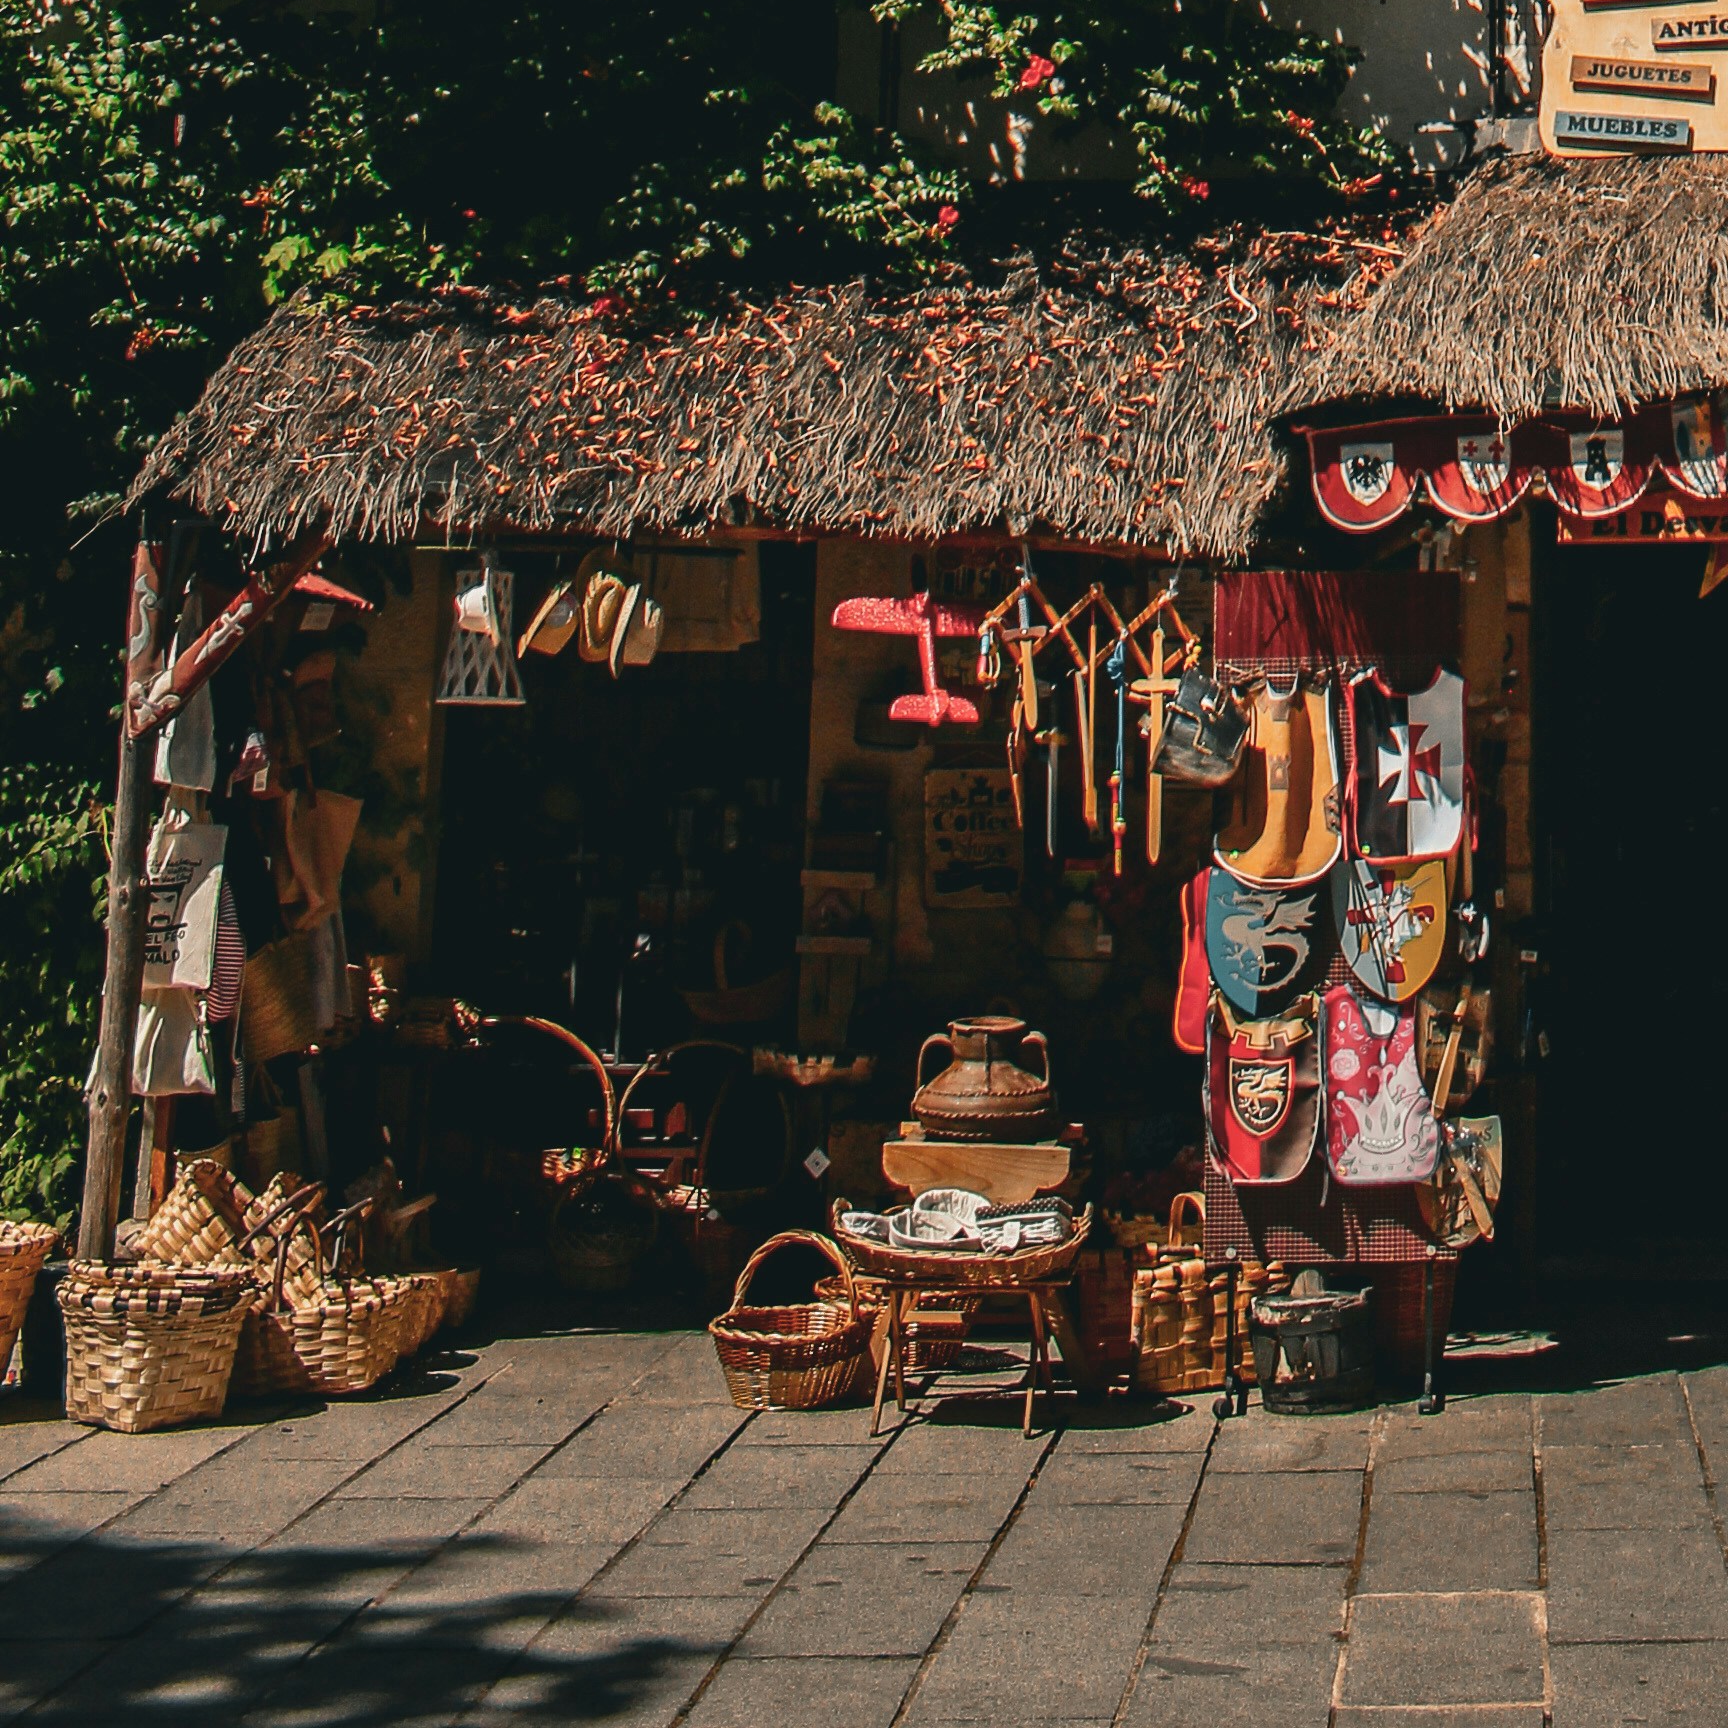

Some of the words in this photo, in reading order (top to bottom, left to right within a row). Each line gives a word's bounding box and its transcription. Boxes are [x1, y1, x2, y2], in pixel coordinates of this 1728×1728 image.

[1588, 63, 1692, 83] JUGUETES
[1567, 115, 1678, 138] MUEBLES
[1592, 512, 1627, 536] El
